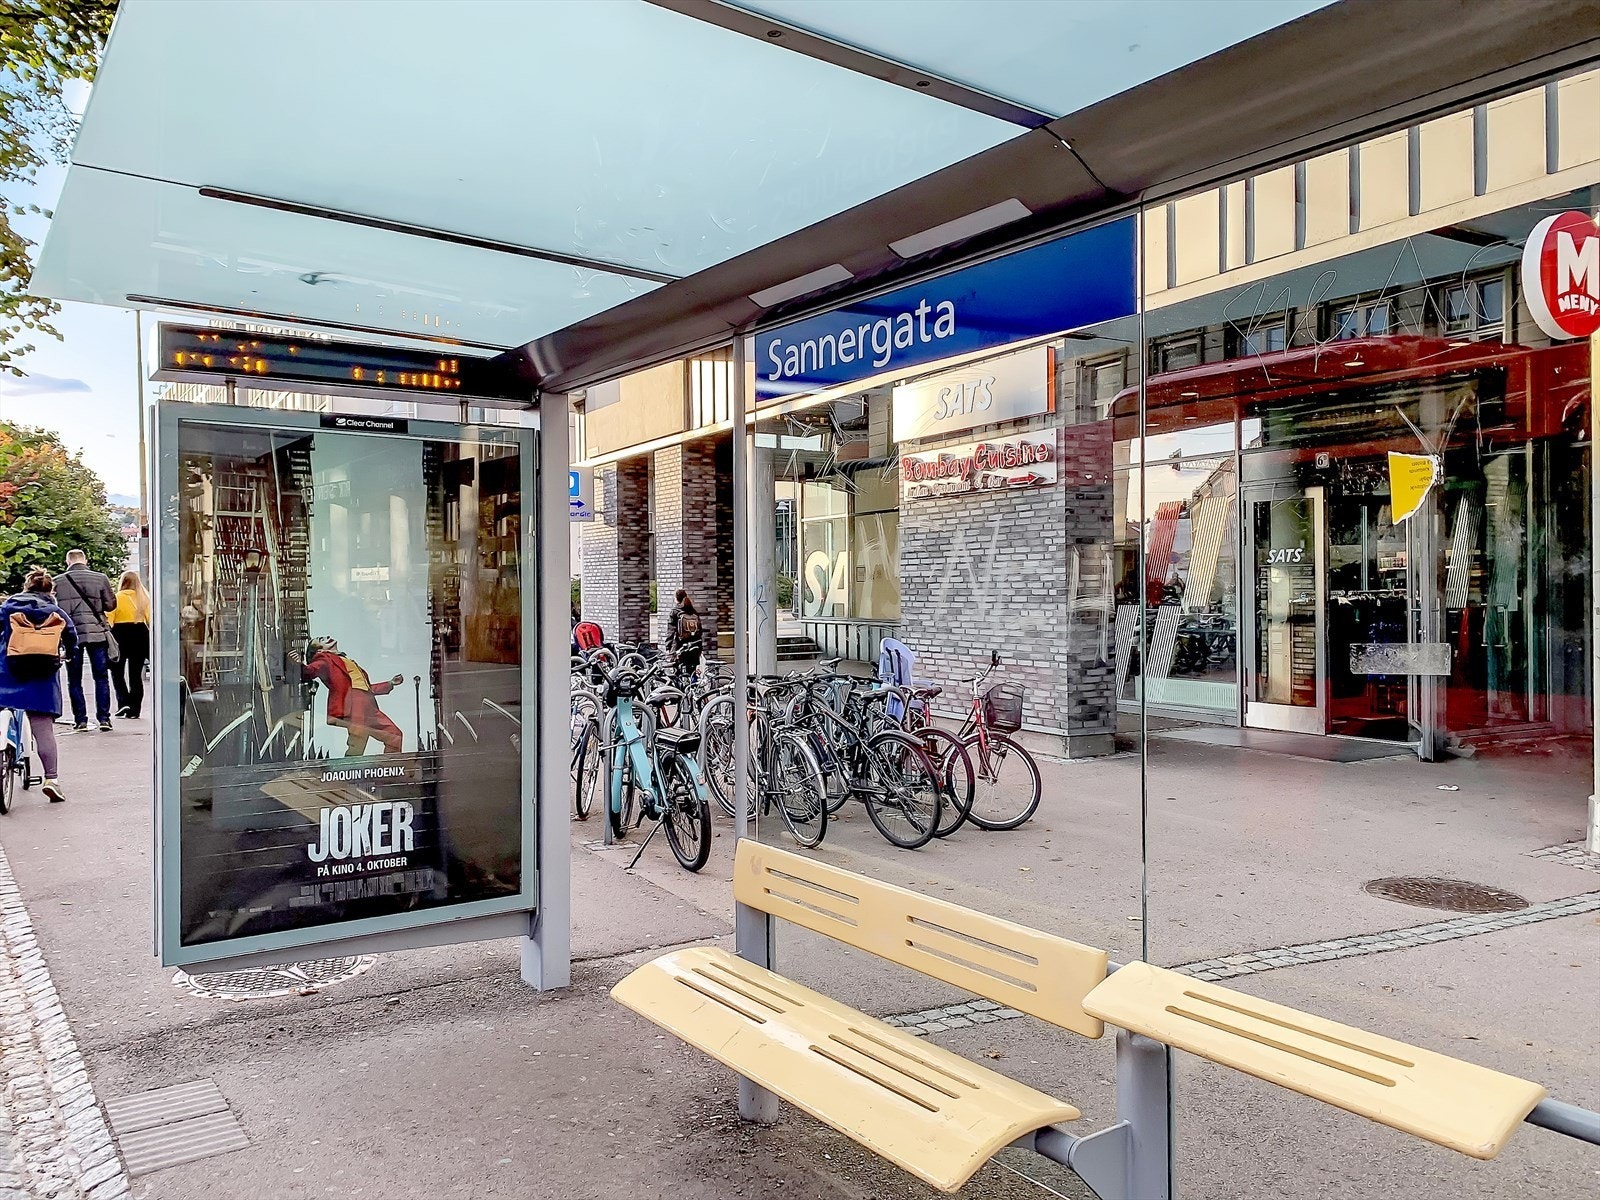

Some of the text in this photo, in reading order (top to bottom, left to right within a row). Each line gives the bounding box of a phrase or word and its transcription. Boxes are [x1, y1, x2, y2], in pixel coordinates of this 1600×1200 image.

[1558, 294, 1600, 316] MENY
[768, 298, 955, 381] Sannergata
[934, 376, 996, 420] SATS
[346, 419, 394, 429] Clear Channel
[902, 440, 1049, 482] Bombay Cuisine
[1266, 548, 1303, 563] SATS
[320, 766, 405, 783] JOAQUIN PHOENIX
[307, 801, 414, 863] JOKER
[317, 856, 408, 877] PÅ KINO 4. OKTOBER
